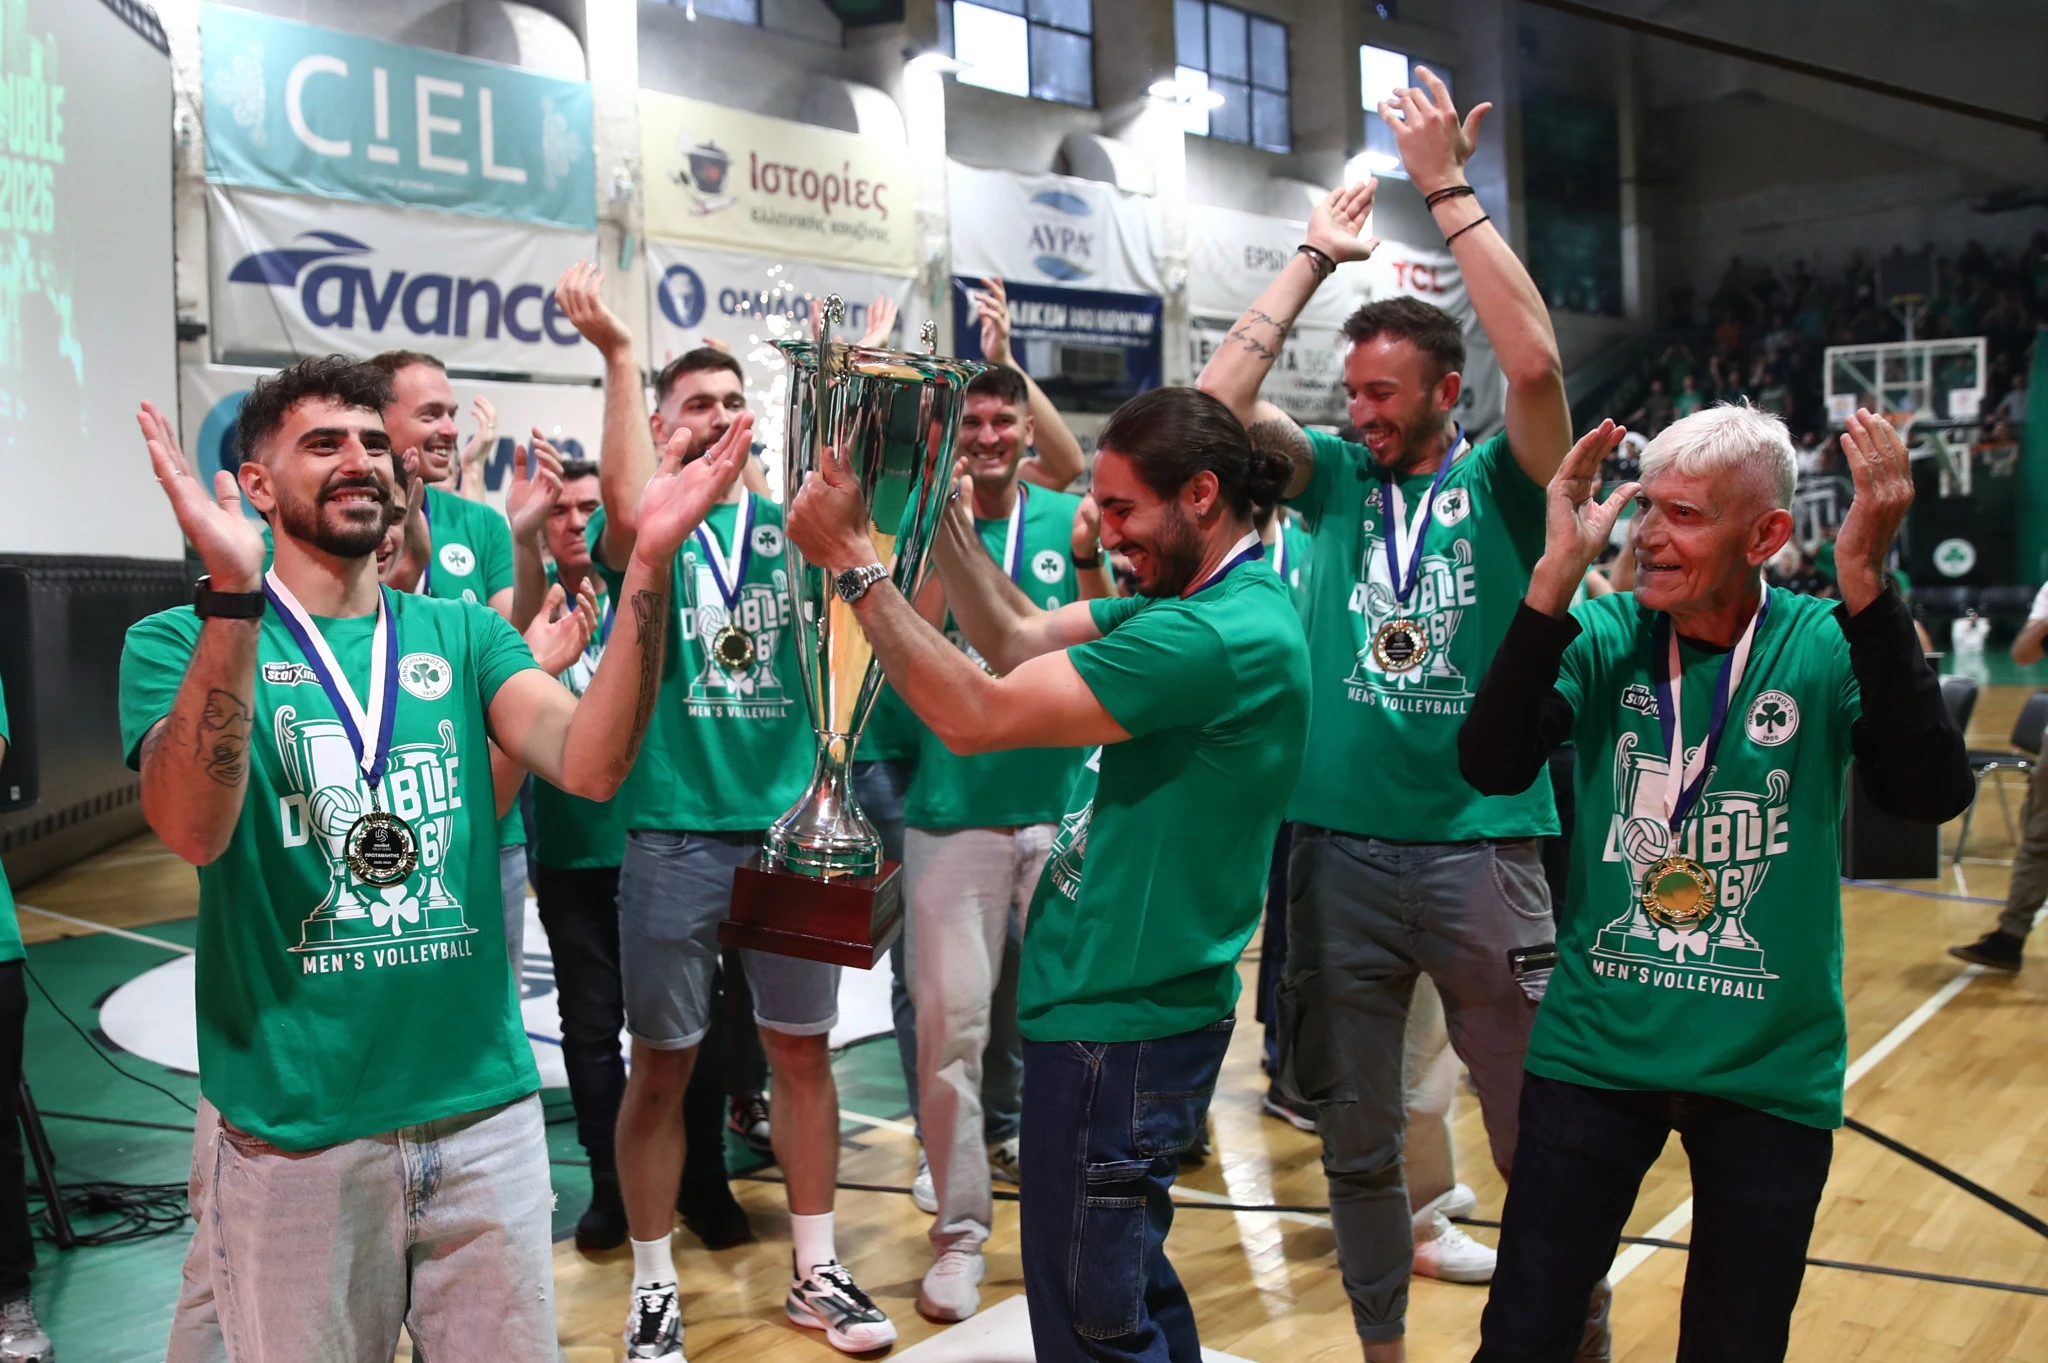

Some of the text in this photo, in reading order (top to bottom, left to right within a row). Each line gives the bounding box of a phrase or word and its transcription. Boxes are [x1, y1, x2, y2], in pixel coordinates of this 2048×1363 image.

[0, 71, 66, 164] UBLE
[284, 54, 528, 184] CIEL
[0, 154, 55, 233] 2026
[750, 151, 889, 221] Ιστορίες
[1392, 260, 1446, 294] TCL
[301, 263, 582, 346] avance
[718, 287, 814, 323] ΟΜΙΛΟ
[688, 705, 787, 719] MEN'S VOLLEYBALL
[1382, 695, 1467, 715] VOLLEYBALL
[302, 939, 473, 975] MEN'S VOLLEYBALL
[1592, 959, 1765, 1000] MEN'S VOLLEYBALL
